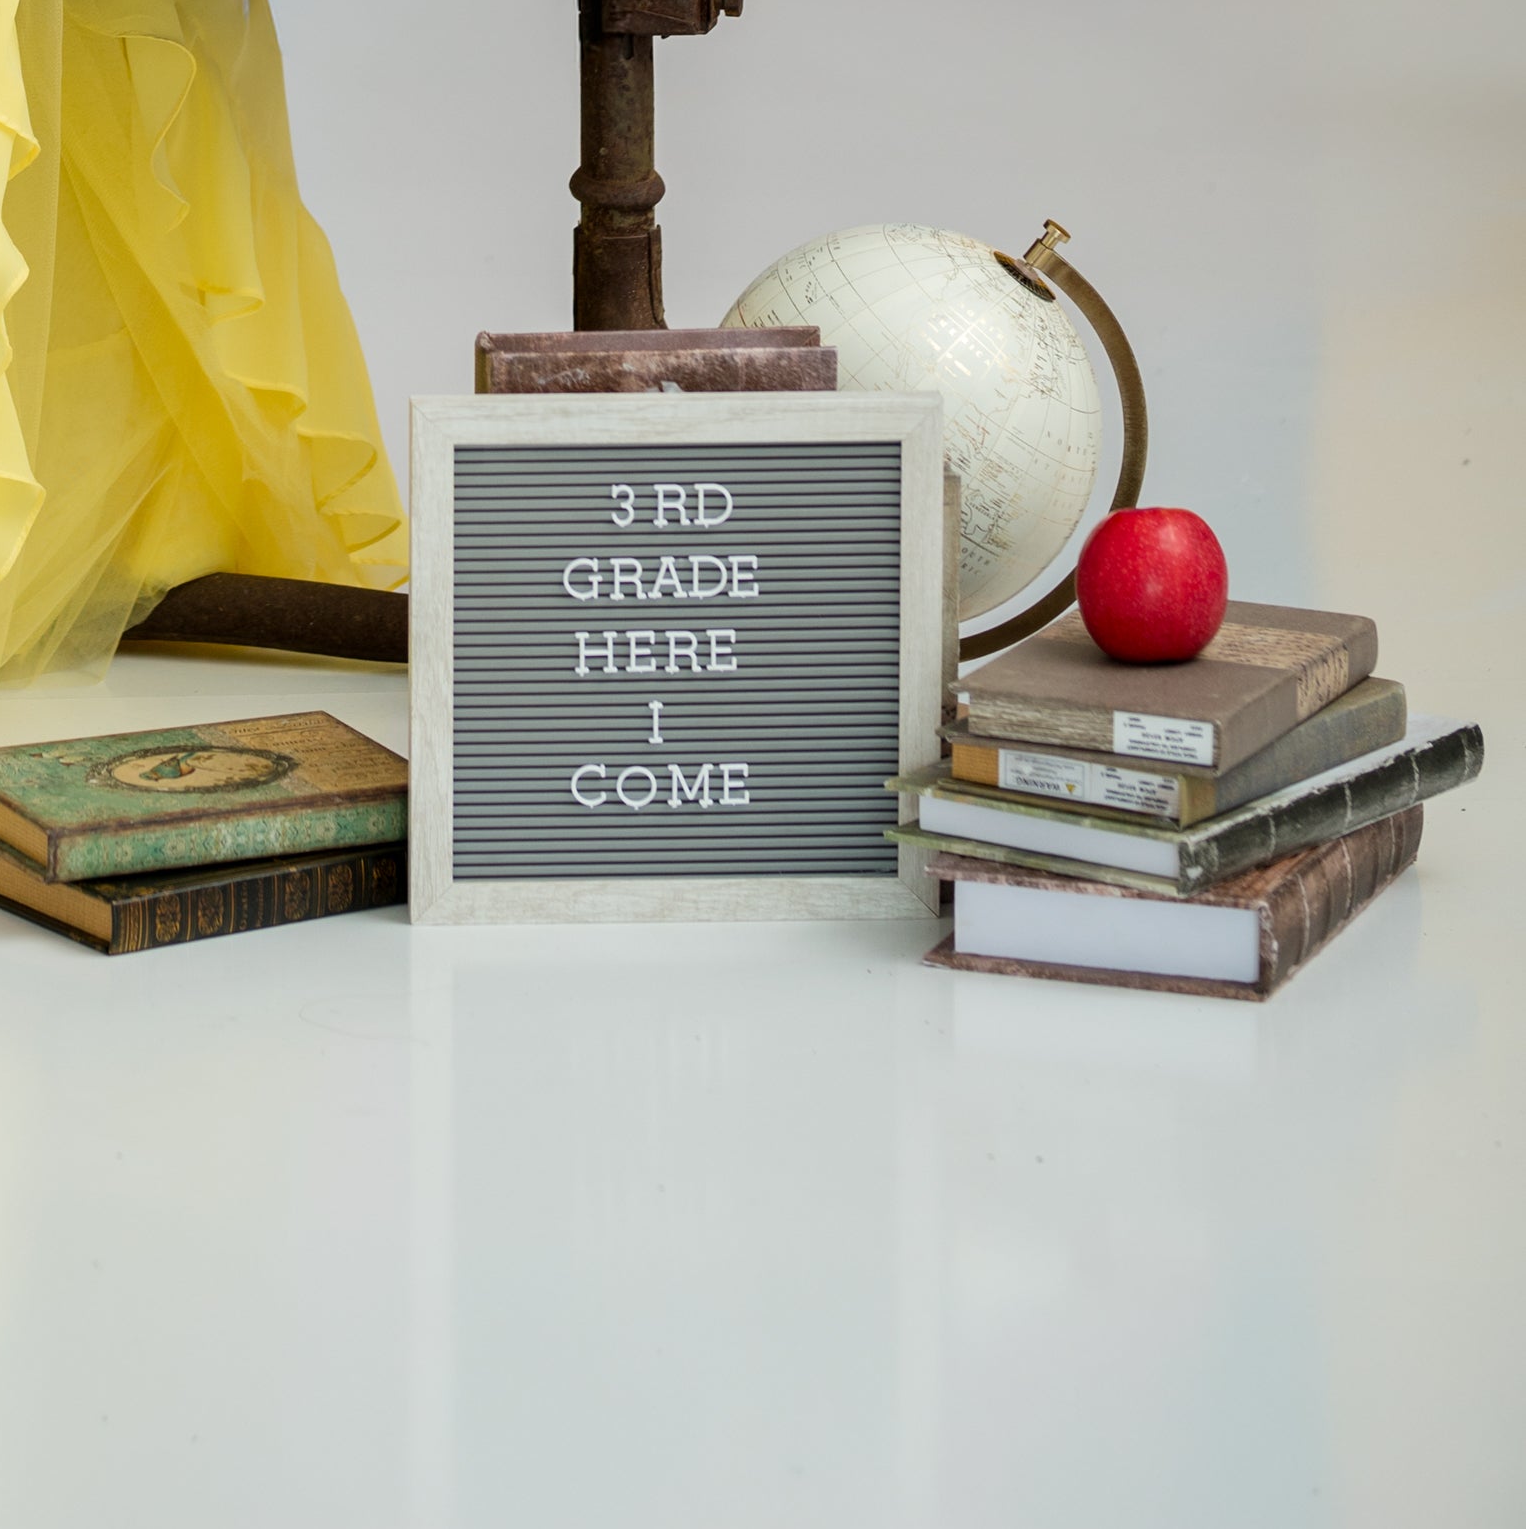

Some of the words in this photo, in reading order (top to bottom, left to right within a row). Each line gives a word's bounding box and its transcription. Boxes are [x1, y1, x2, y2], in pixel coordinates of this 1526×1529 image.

[562, 555, 760, 601] GRADE
[574, 629, 738, 677] HERE
[647, 700, 664, 744] I
[570, 763, 751, 810] COME
